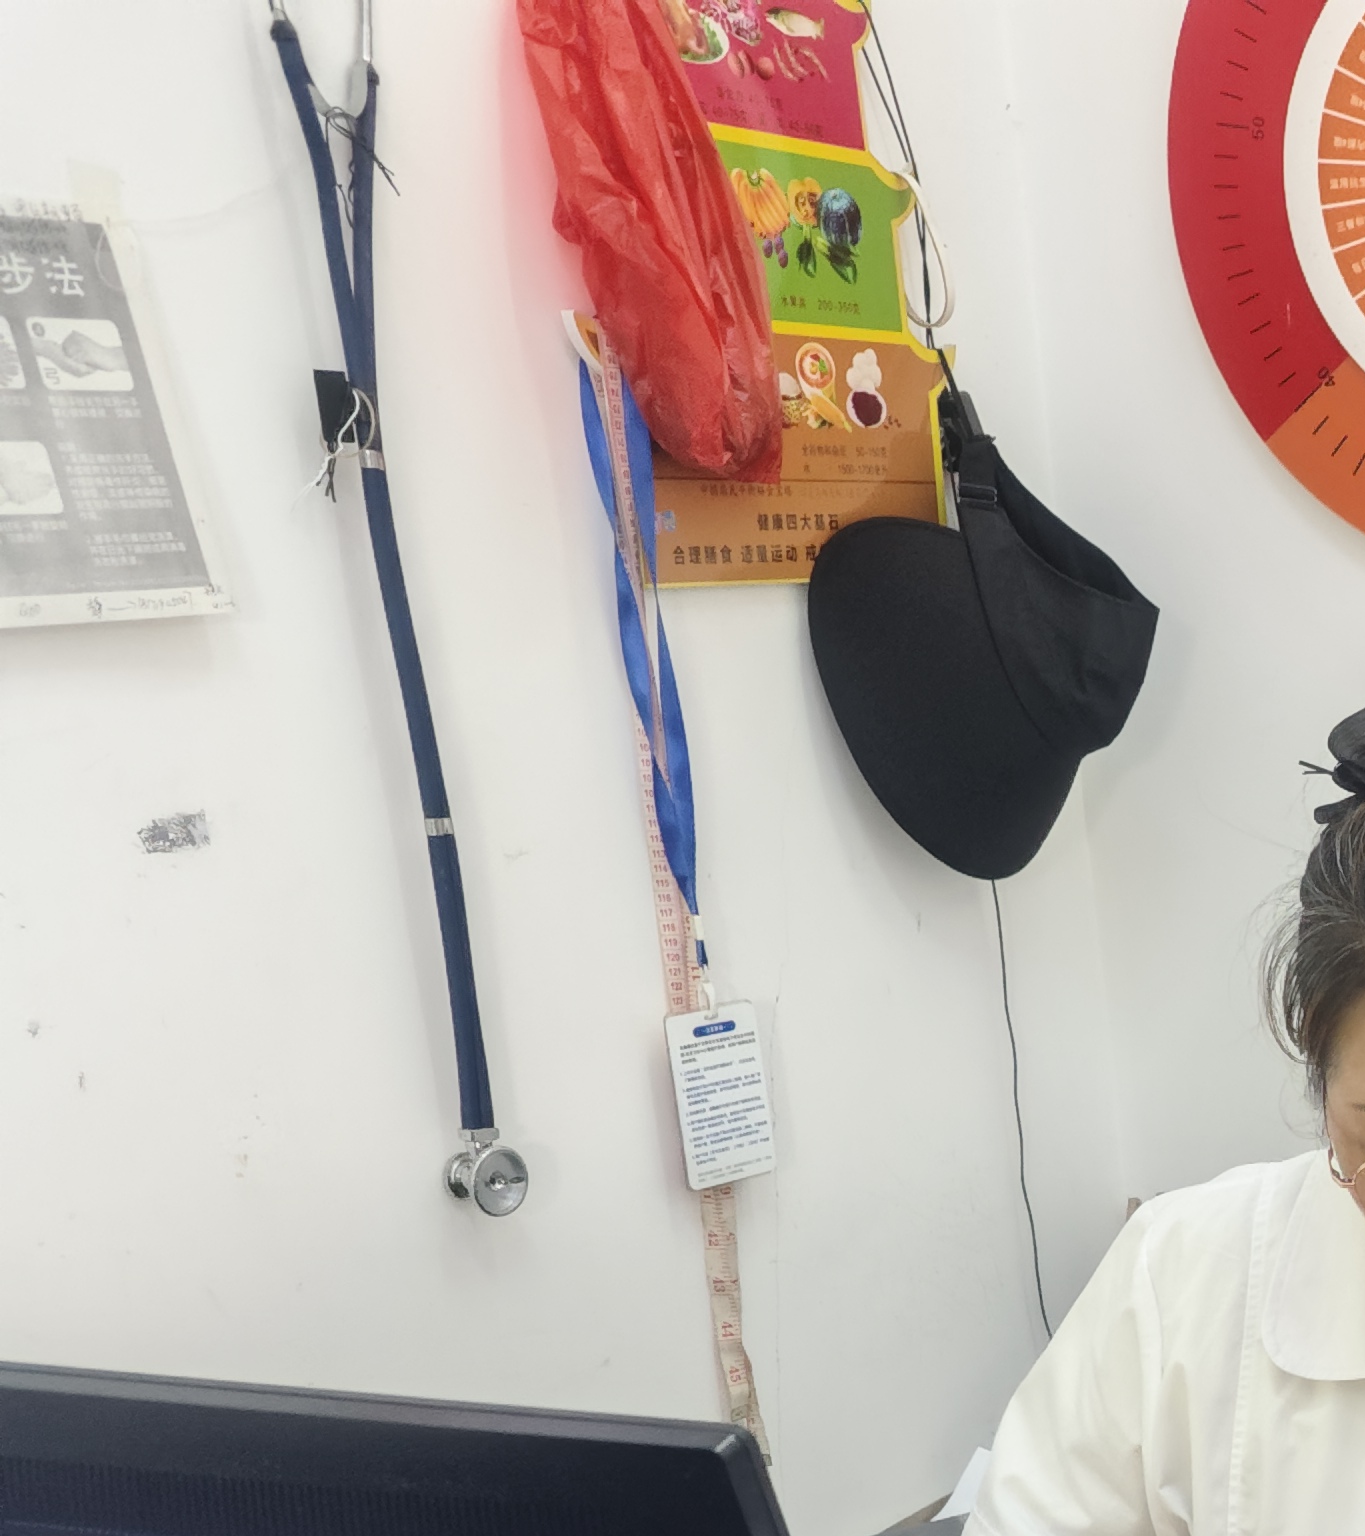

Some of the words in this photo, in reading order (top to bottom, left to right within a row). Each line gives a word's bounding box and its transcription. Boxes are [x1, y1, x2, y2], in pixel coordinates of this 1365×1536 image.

[1252, 116, 1265, 140] 50
[1317, 366, 1336, 387] 40
[757, 513, 840, 532] 健康四大基石
[672, 545, 733, 566] 合理膳食
[740, 544, 798, 564] 适量运动
